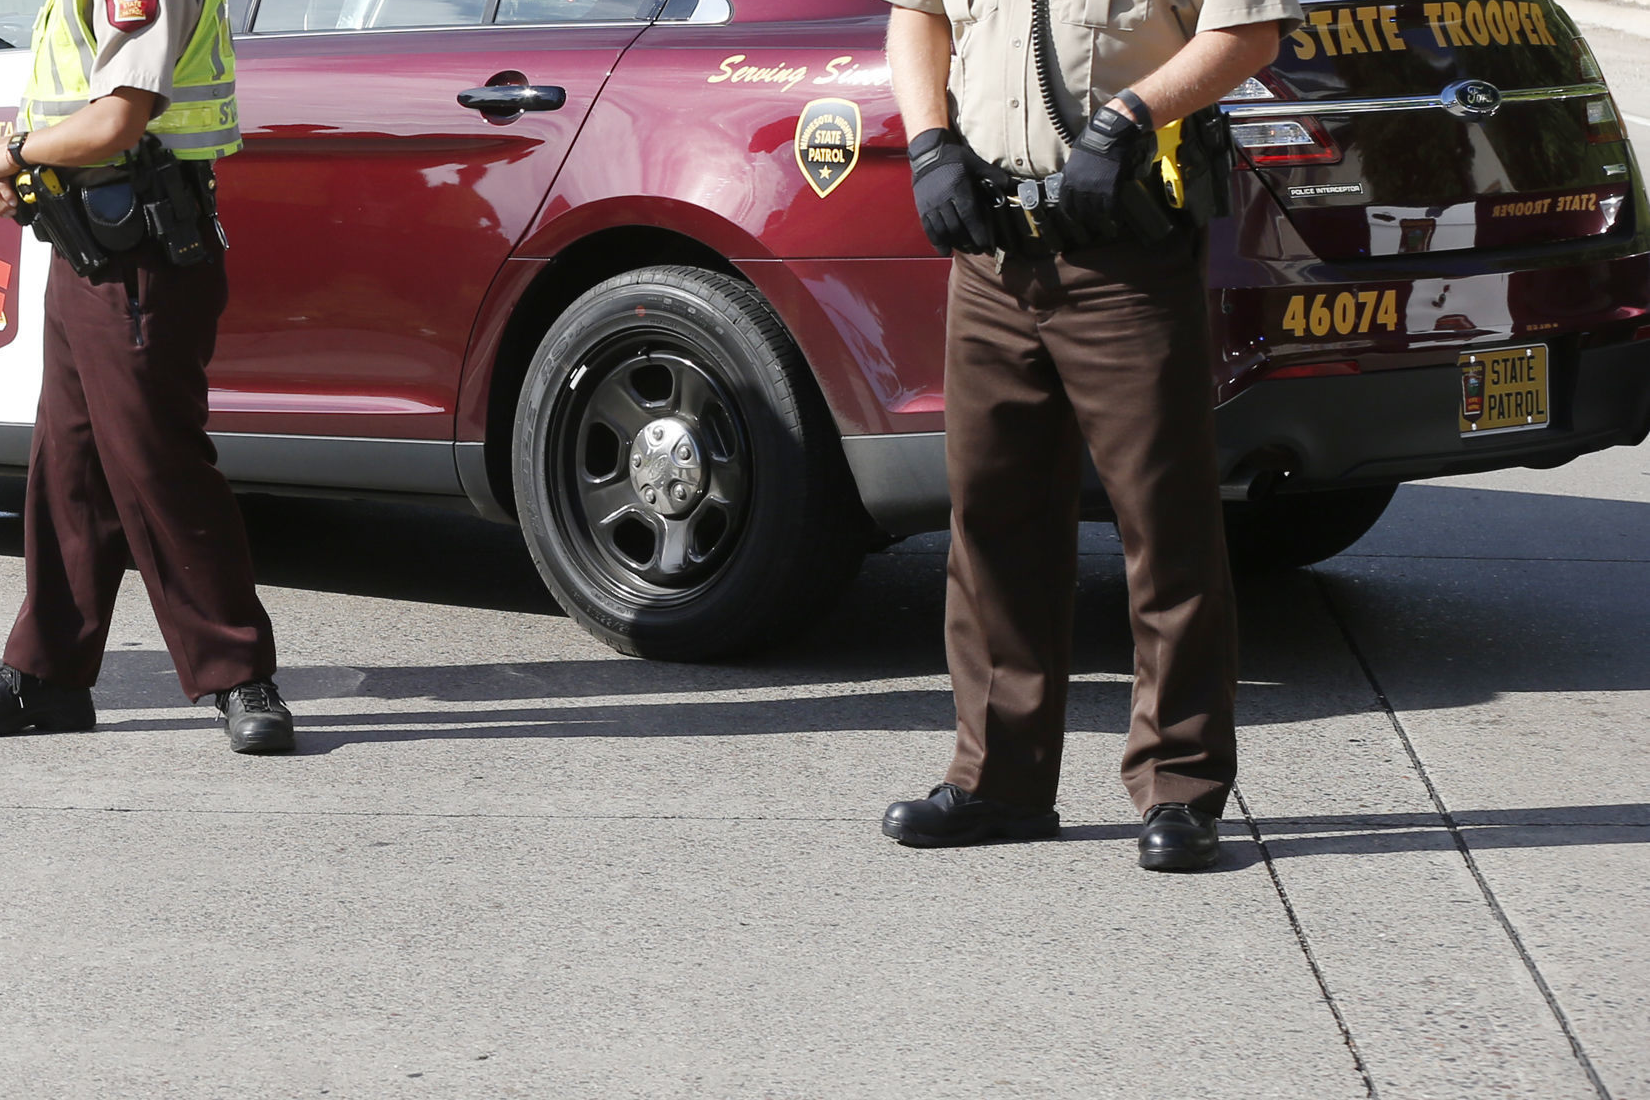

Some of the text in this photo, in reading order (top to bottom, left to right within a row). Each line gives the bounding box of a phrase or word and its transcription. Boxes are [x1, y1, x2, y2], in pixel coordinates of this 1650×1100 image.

[1293, 0, 1557, 61] STATE TROOPER
[707, 54, 808, 93] Serving
[1467, 85, 1494, 104] Ford
[800, 114, 833, 150] MINNESOTA
[814, 130, 843, 145] STATE
[808, 148, 846, 163] PATROL
[1291, 185, 1361, 196] POLICE INTERCEPTOR
[1282, 289, 1398, 337] 46074
[1491, 355, 1536, 386] STATE
[1488, 389, 1545, 421] PATROL
